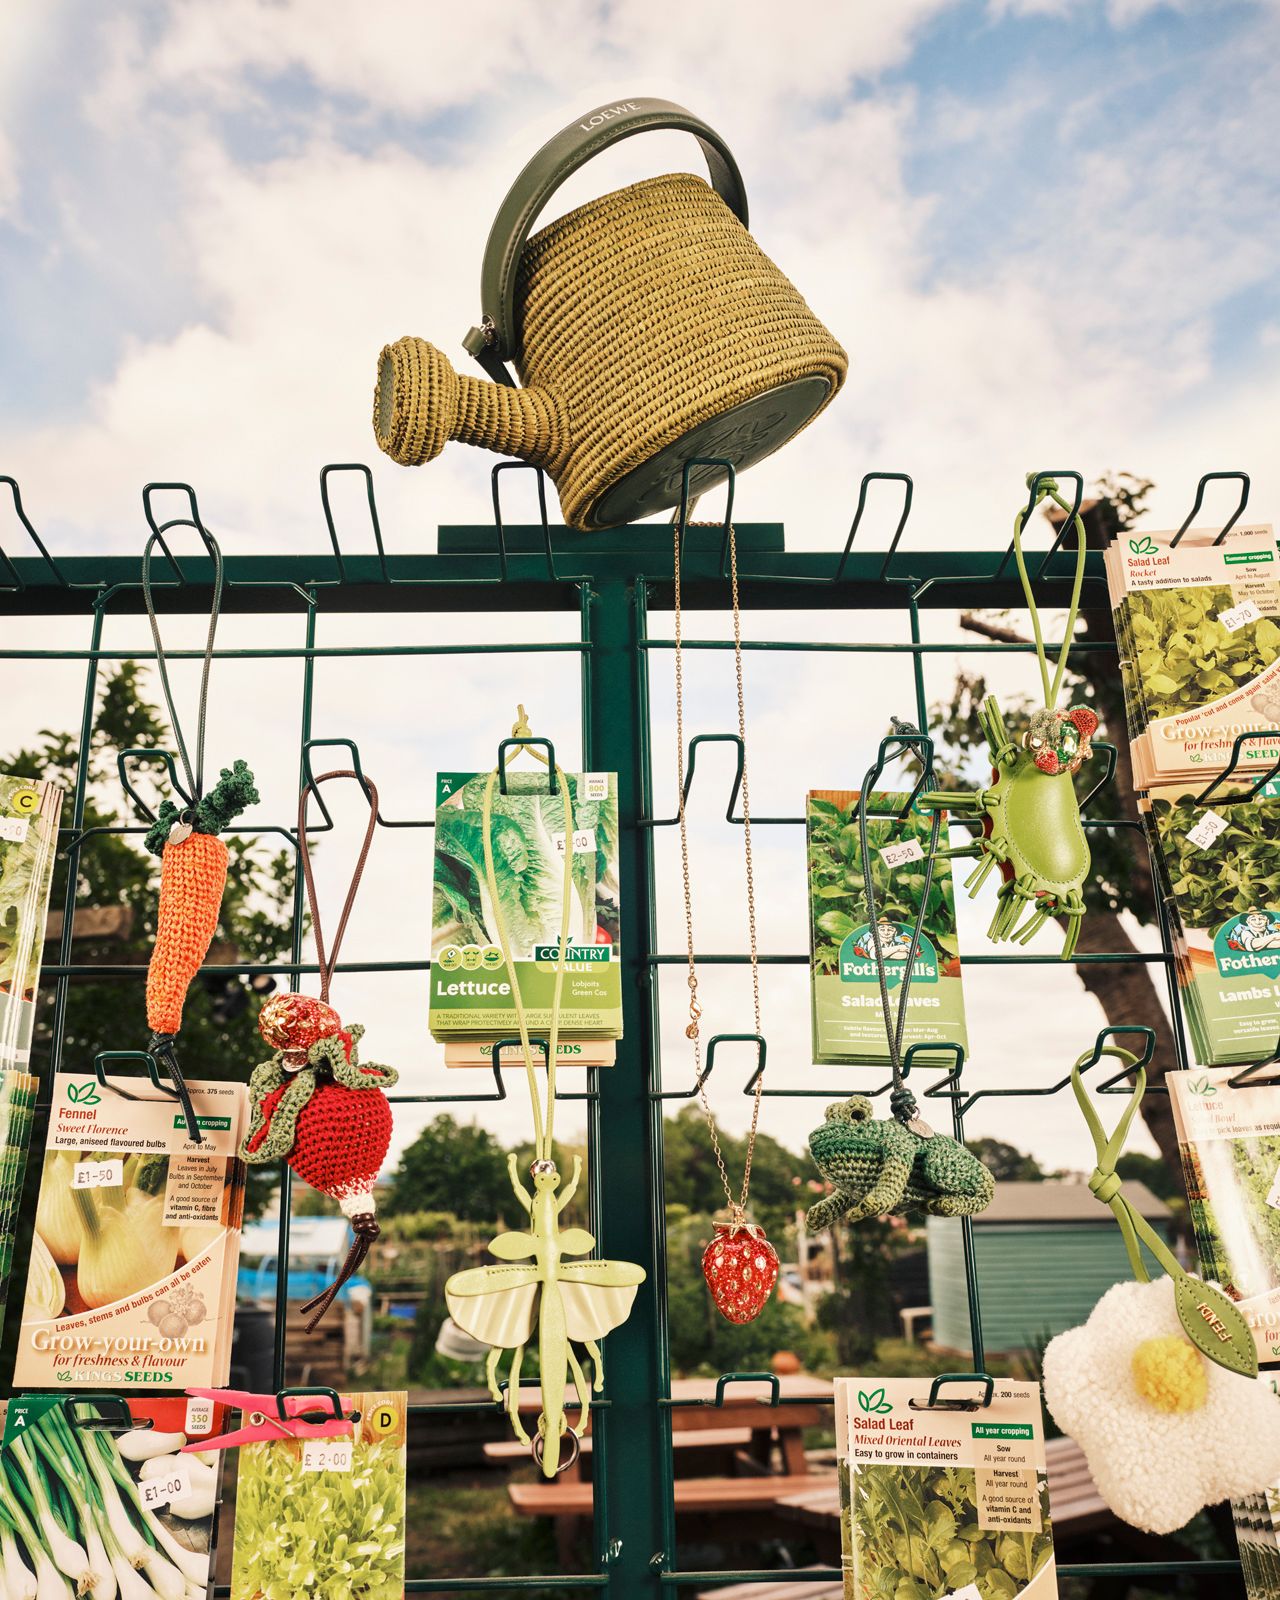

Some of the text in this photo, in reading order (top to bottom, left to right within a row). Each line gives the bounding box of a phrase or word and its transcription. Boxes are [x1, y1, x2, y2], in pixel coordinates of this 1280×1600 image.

[580, 101, 641, 131] LOEWE
[1127, 556, 1170, 567] Salad Leaf
[1130, 569, 1157, 578] Rocket
[1155, 577, 1182, 585] addition
[1225, 609, 1252, 629] £1-70
[1175, 713, 1201, 726] Popular
[1216, 703, 1228, 713] and
[1228, 695, 1245, 706] come
[1245, 682, 1261, 697] again'
[1262, 671, 1276, 685] salad
[1184, 737, 1257, 752] for freshns &
[1246, 749, 1279, 759] SEED
[442, 784, 451, 793] A
[20, 795, 33, 808] C
[1195, 821, 1218, 845] £1-50
[557, 836, 588, 851] £-00
[886, 848, 914, 864] £2-50
[1219, 953, 1280, 971] Fother
[843, 962, 936, 981] Fothergll's
[437, 981, 511, 996] Lettuce
[572, 981, 600, 989] Lobjoits
[1219, 986, 1272, 1003] Lambs
[841, 995, 883, 1007] Salad
[538, 1044, 582, 1055] SEDS
[58, 1107, 97, 1120] Fennel
[56, 1123, 129, 1136] Sweet Florence
[201, 1120, 228, 1128] cropping
[55, 1136, 166, 1148] Large, aniseed flavoured bulbs
[78, 1168, 113, 1184] £1-50
[193, 1174, 224, 1182] September
[190, 1182, 213, 1190] October
[176, 1195, 191, 1203] good
[178, 1213, 219, 1221] anti-oxidants
[55, 1256, 212, 1333] Leaves, stems and bulbs can all be eaten
[1196, 1302, 1233, 1342] FENDI
[31, 1328, 205, 1357] Grow-your-own
[52, 1353, 188, 1369] for freshness & flavour
[74, 1371, 173, 1383] KINGS SEEDS
[13, 1415, 26, 1427] A
[191, 1414, 208, 1423] 350
[380, 1413, 392, 1428] D
[853, 1417, 914, 1431] Salad Leaf
[975, 1426, 1030, 1436] All year cropping
[854, 1434, 962, 1448] Mixed Oriental Leaves
[854, 1448, 959, 1460] Easy to grow in containers
[996, 1444, 1011, 1452] Sow
[305, 1453, 312, 1466] £
[993, 1455, 1006, 1463] year
[993, 1470, 1019, 1478] Harvest
[985, 1479, 994, 1487] All
[145, 1479, 182, 1501] £1-00
[982, 1494, 987, 1502] A
[988, 1495, 1004, 1503] good
[1027, 1496, 1034, 1504] of
[986, 1505, 1011, 1513] vitamin
[988, 1516, 1032, 1524] anti-oxidants
